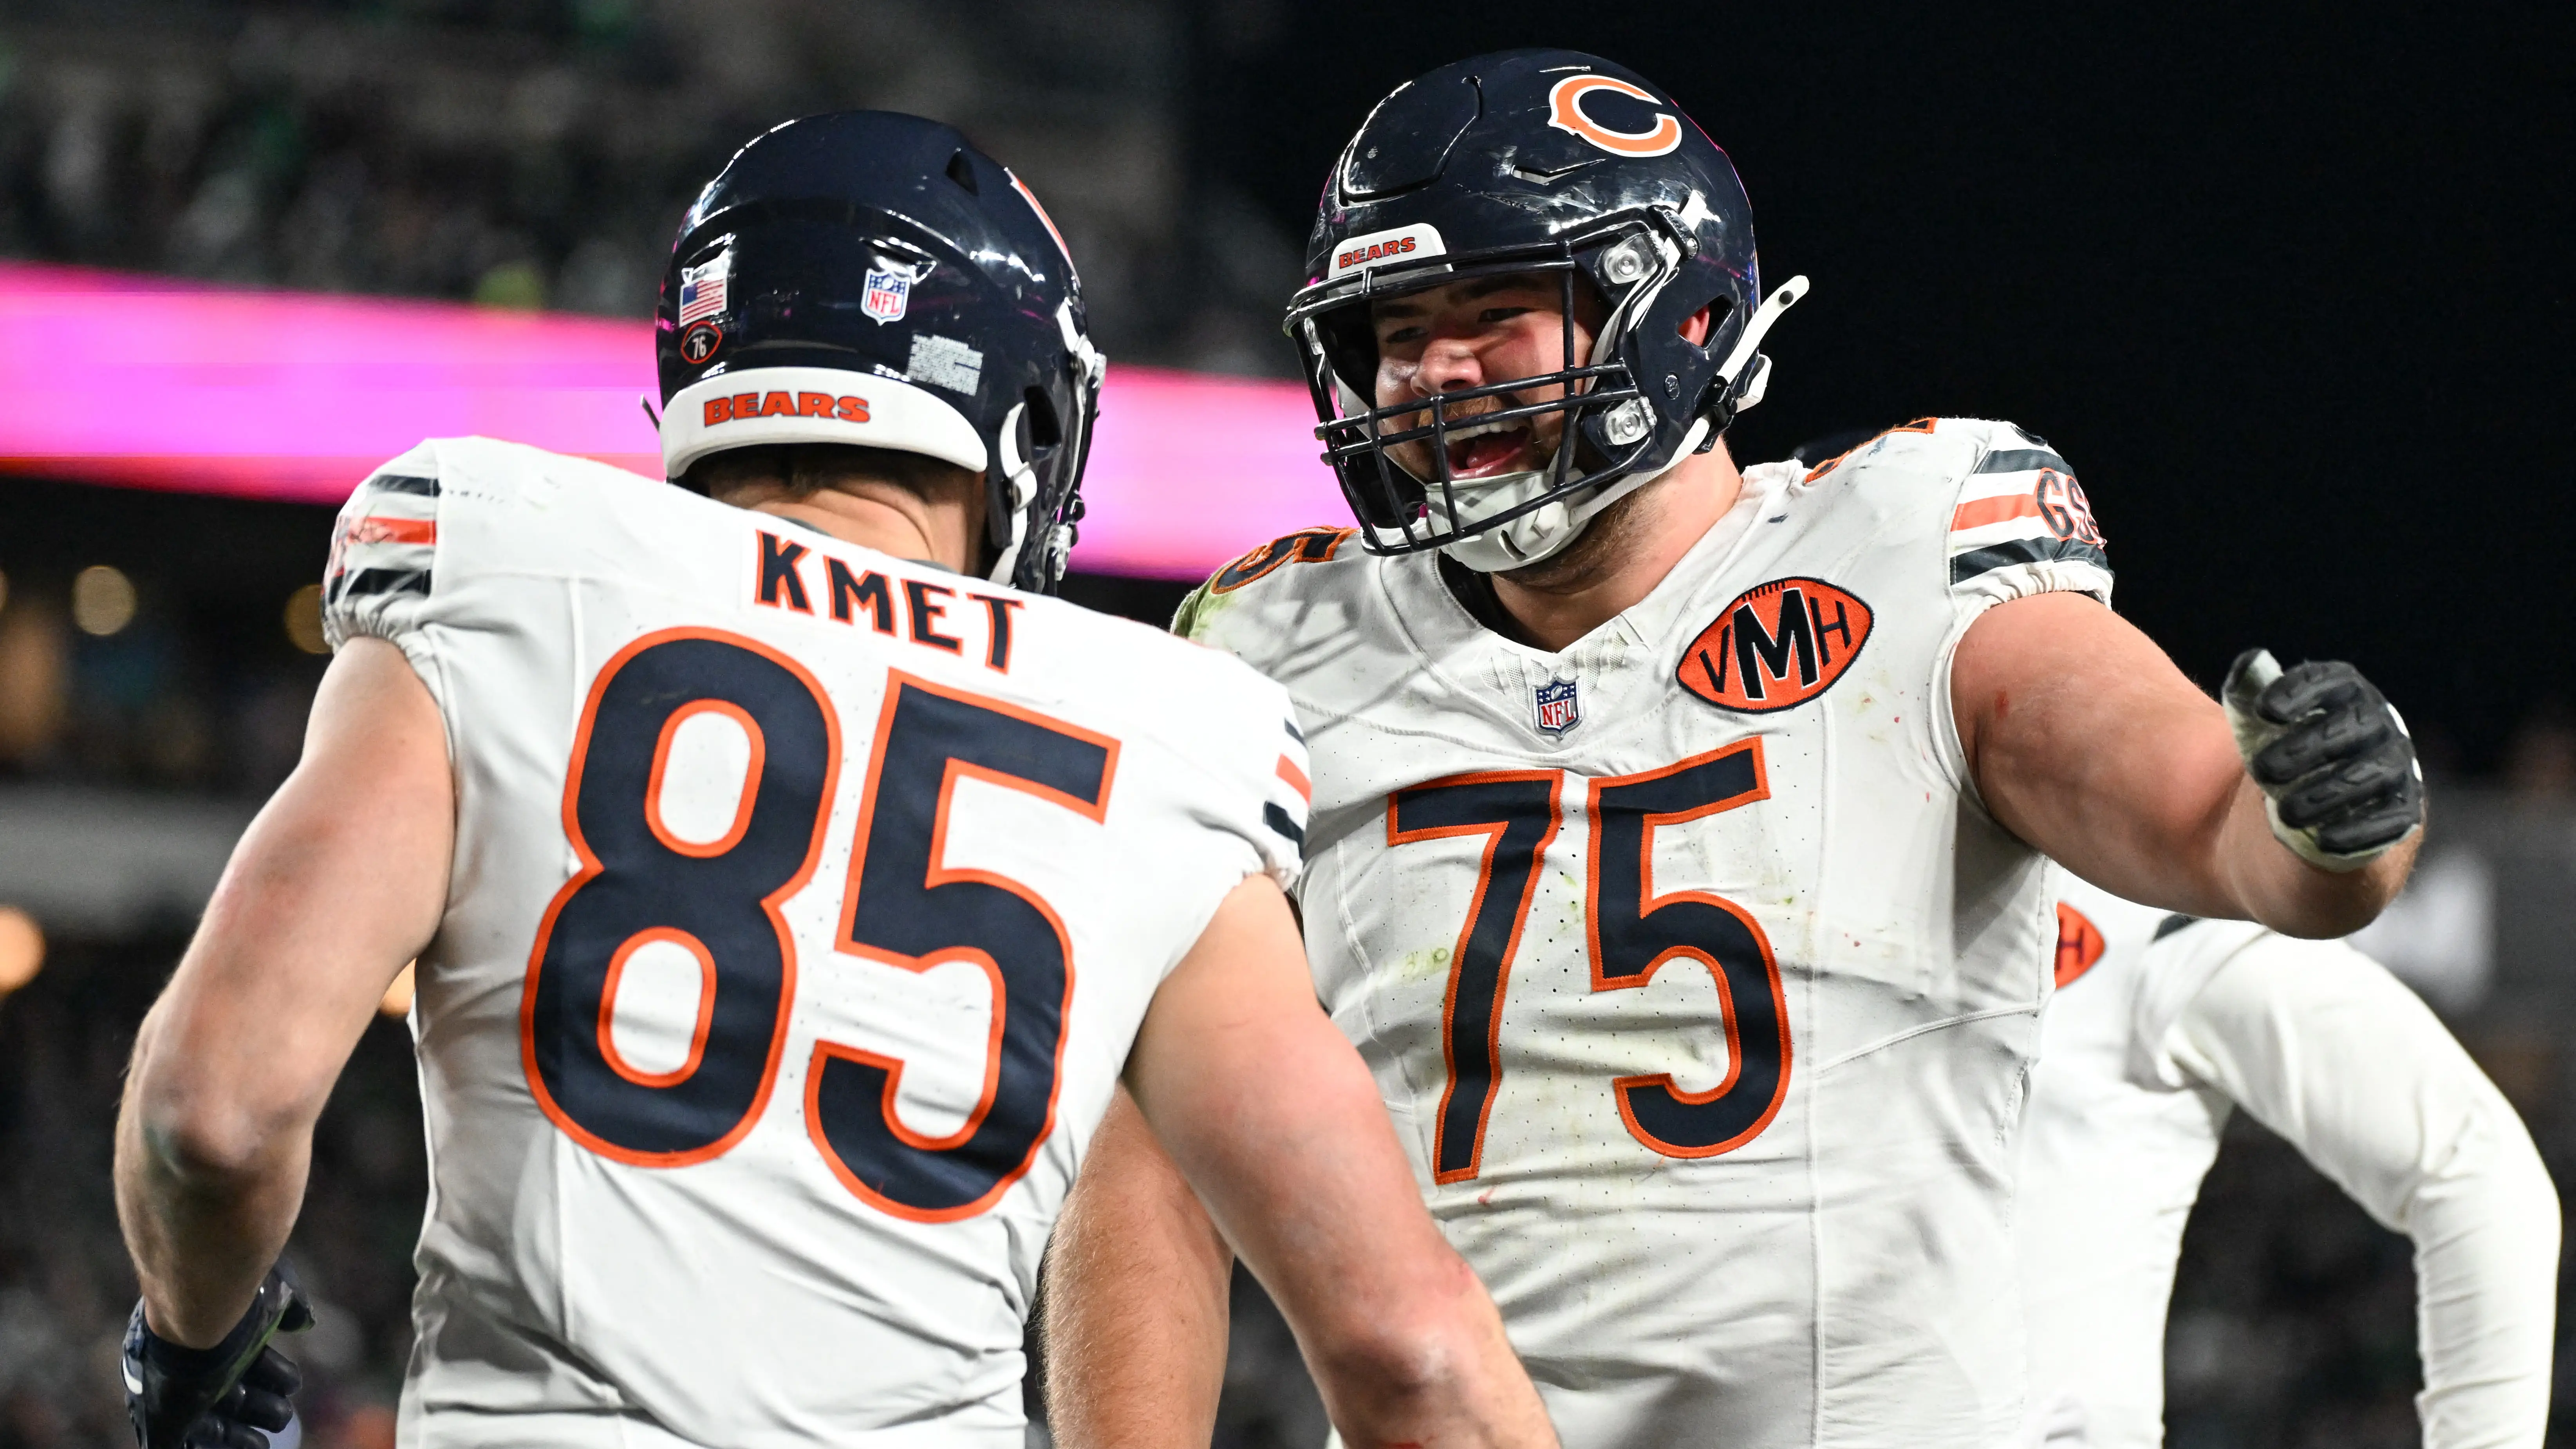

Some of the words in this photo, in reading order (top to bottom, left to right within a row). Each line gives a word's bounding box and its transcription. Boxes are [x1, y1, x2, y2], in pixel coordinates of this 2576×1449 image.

[1548, 74, 1682, 157] C
[1339, 237, 1416, 269] BEARS
[868, 289, 900, 314] NFL
[692, 334, 707, 360] 76
[704, 391, 870, 428] BEARS
[2034, 467, 2107, 549] GS
[753, 528, 1024, 674] KMET
[1541, 699, 1576, 727] NFL
[520, 625, 1122, 1223] 85
[1387, 735, 1793, 1185] 75
